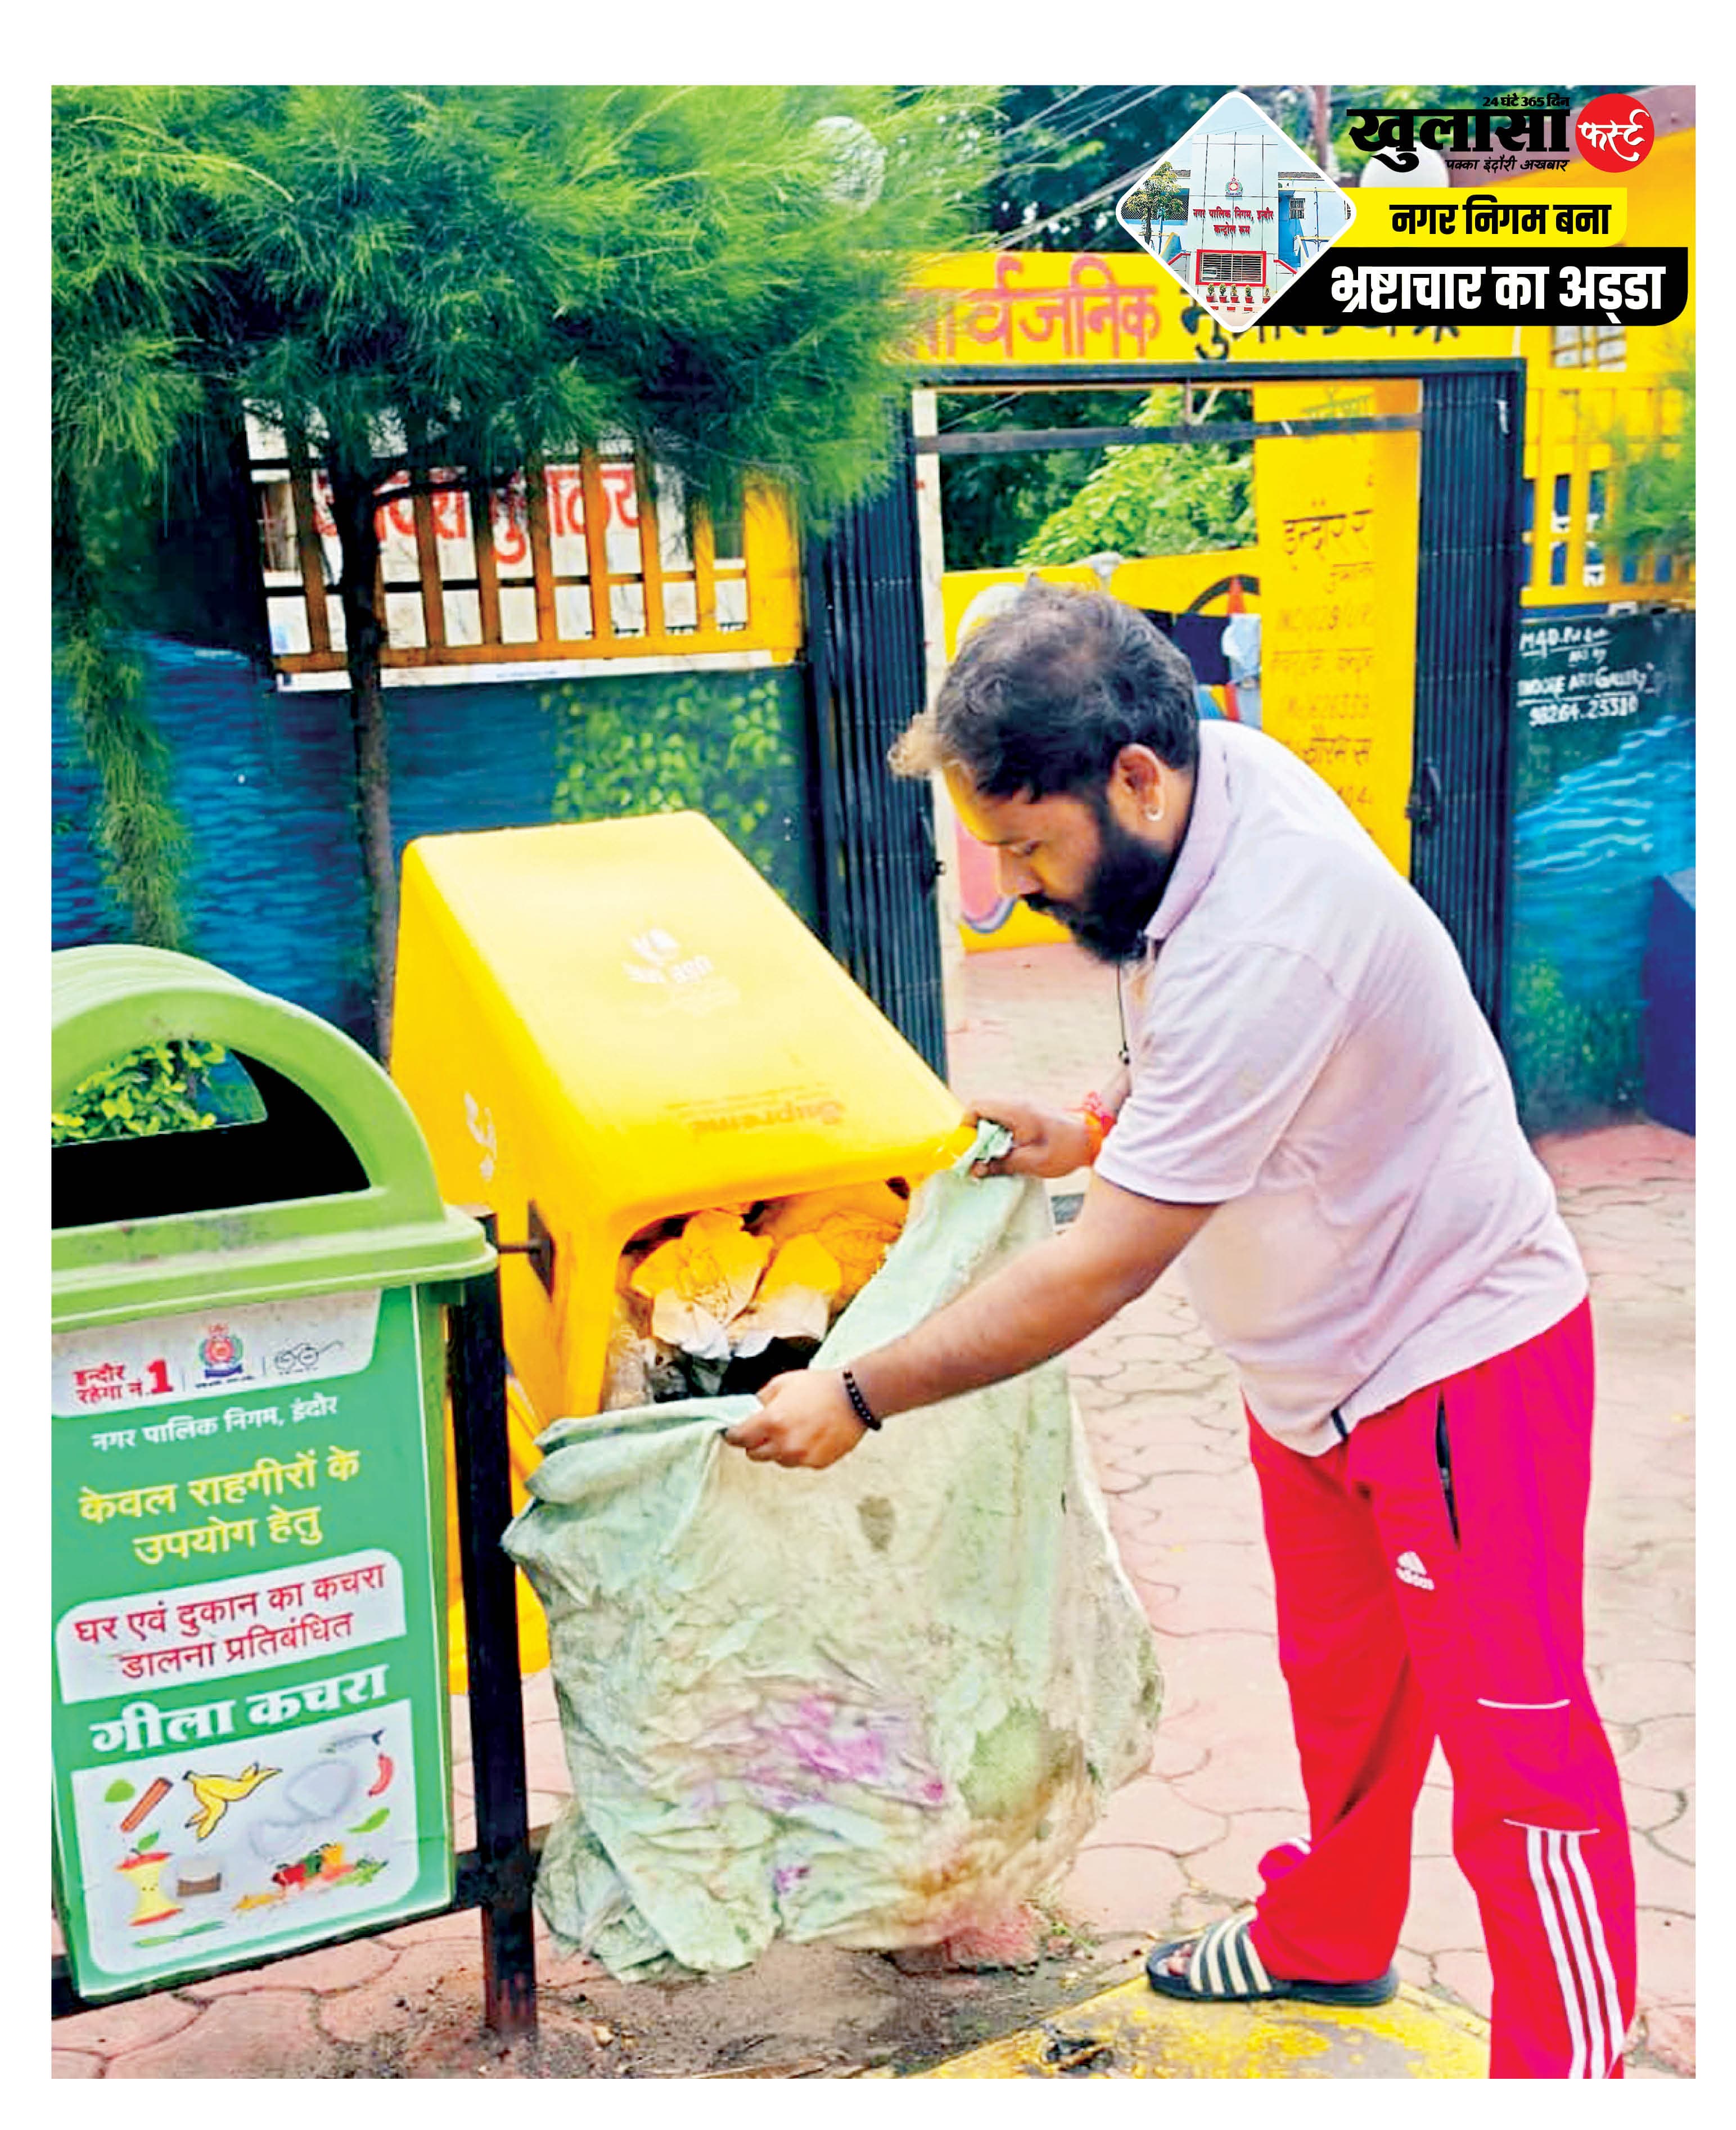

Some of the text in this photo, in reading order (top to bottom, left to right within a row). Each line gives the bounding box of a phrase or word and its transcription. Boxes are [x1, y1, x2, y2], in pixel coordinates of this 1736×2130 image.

[1193, 209, 1206, 218] नगर
[1209, 206, 1231, 218] पालिक
[73, 1362, 126, 1387] इन्दौर
[76, 1382, 123, 1404] रहेगा
[91, 1392, 339, 1452] नगर पालिक निगम, इंदौर
[78, 1445, 361, 1524] केवल राहगीरों के
[132, 1504, 323, 1565] उपयोग हेतु
[74, 1564, 386, 1644] घर एवं दुकान का कचरा
[119, 1612, 353, 1679] डालना प्रतिबंधित
[89, 1664, 390, 1753] गीला कचरा
